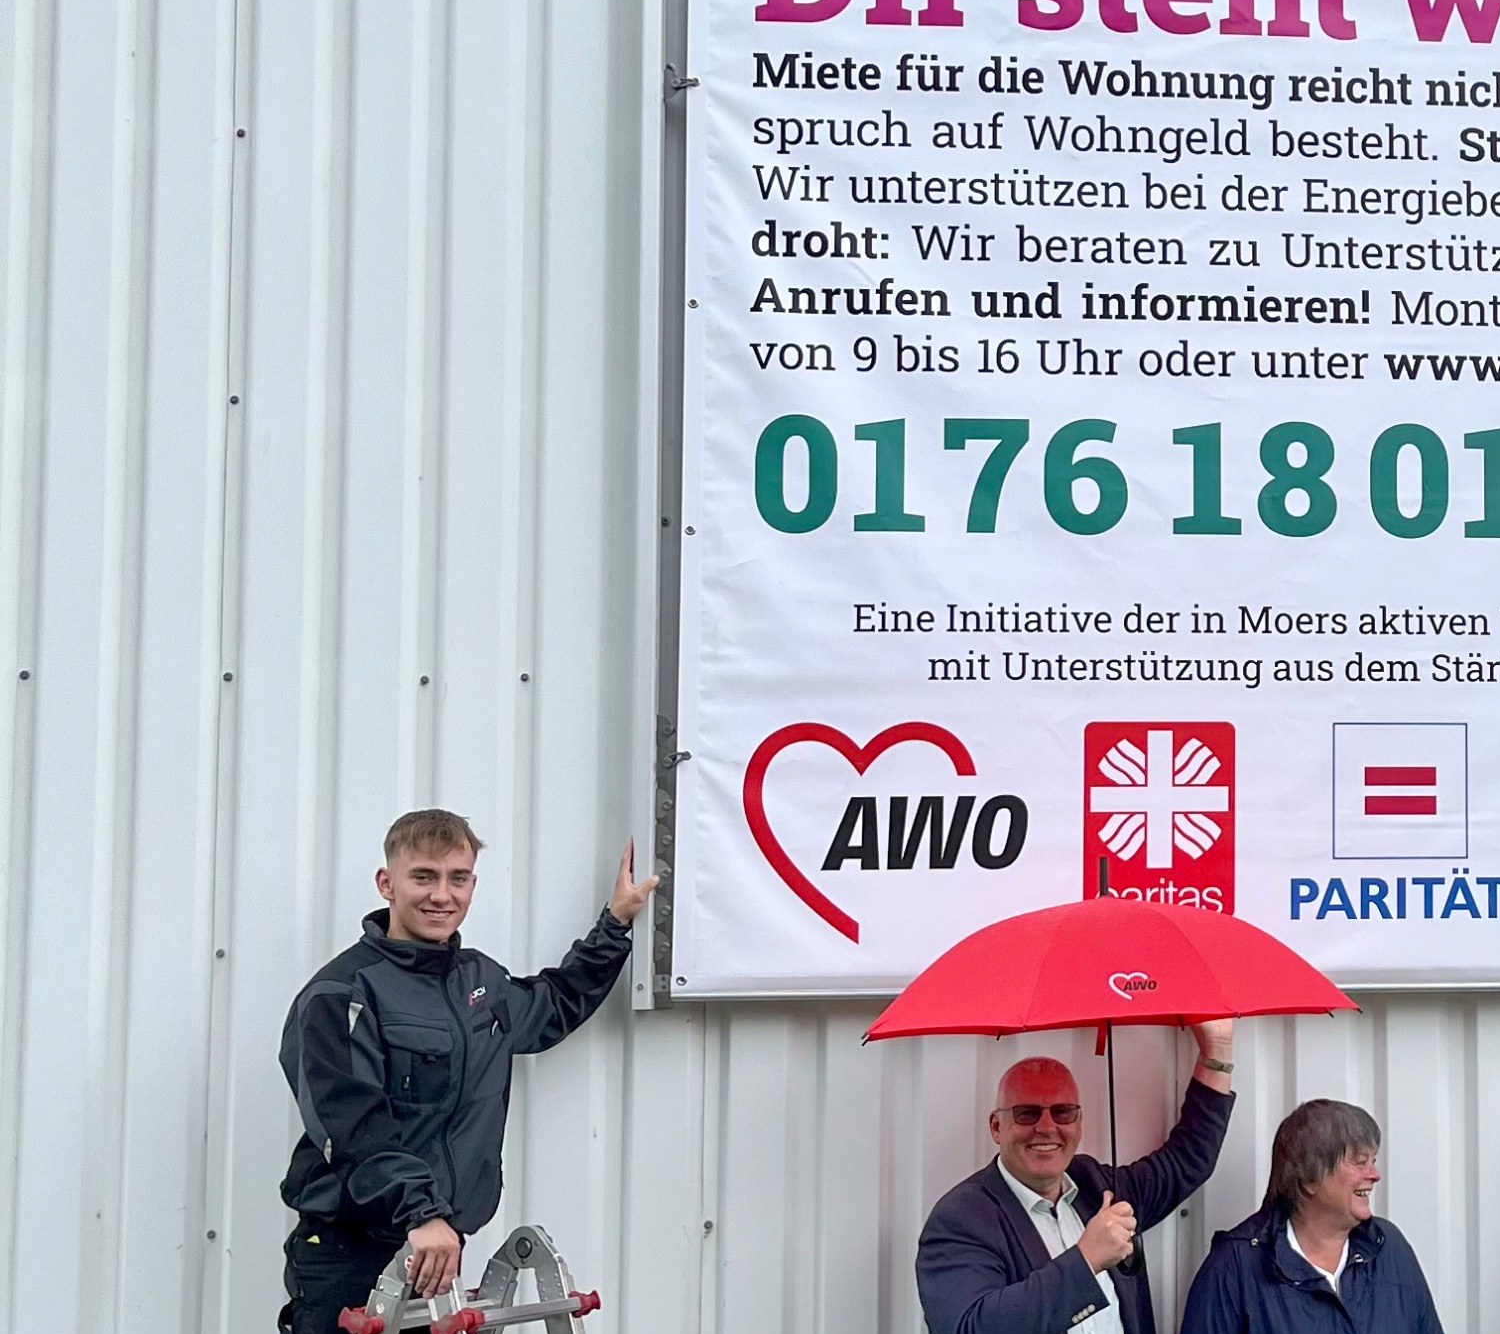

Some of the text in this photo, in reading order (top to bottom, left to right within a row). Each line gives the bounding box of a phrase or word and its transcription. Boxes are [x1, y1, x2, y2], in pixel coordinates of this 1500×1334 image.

[753, 52, 881, 90] Miete
[896, 54, 964, 92] für
[979, 56, 1044, 94] die
[1058, 60, 1275, 110] Wohnung
[1289, 67, 1412, 105] reicht
[754, 110, 911, 154] spruch
[933, 112, 1004, 149] auf
[1024, 115, 1250, 163] Wohngeld
[1269, 120, 1437, 160] besteht.
[752, 165, 834, 202] Wir
[849, 169, 1129, 208] unterstützen
[1142, 172, 1206, 210] bei
[1222, 175, 1288, 211] der
[752, 220, 889, 259] droht:
[911, 224, 995, 261] Wir
[1016, 225, 1187, 265] beraten
[1209, 240, 1260, 266] zu
[750, 278, 951, 316] Anrufen
[971, 282, 1062, 319] und
[1082, 282, 1369, 324] informieren!
[750, 343, 835, 370] von
[854, 337, 876, 372] 9
[893, 335, 959, 372] bis
[978, 339, 1019, 373] 16
[1037, 338, 1122, 375] Uhr
[1139, 340, 1235, 377] oder
[1252, 347, 1368, 379] unter
[755, 414, 1128, 535] 0176
[1173, 422, 1337, 537] 18
[854, 602, 934, 632] Eine
[947, 603, 1111, 633] Initiative
[1124, 603, 1180, 633] der
[1191, 604, 1226, 633] in
[1238, 606, 1347, 634] Moers
[1359, 605, 1490, 635] aktiven
[928, 650, 990, 680] mit
[1003, 651, 1263, 688] Unterstützung
[1274, 660, 1333, 681] aus
[1345, 652, 1420, 681] dem
[821, 795, 1027, 870] AWO
[1122, 979, 1157, 992] AWO
